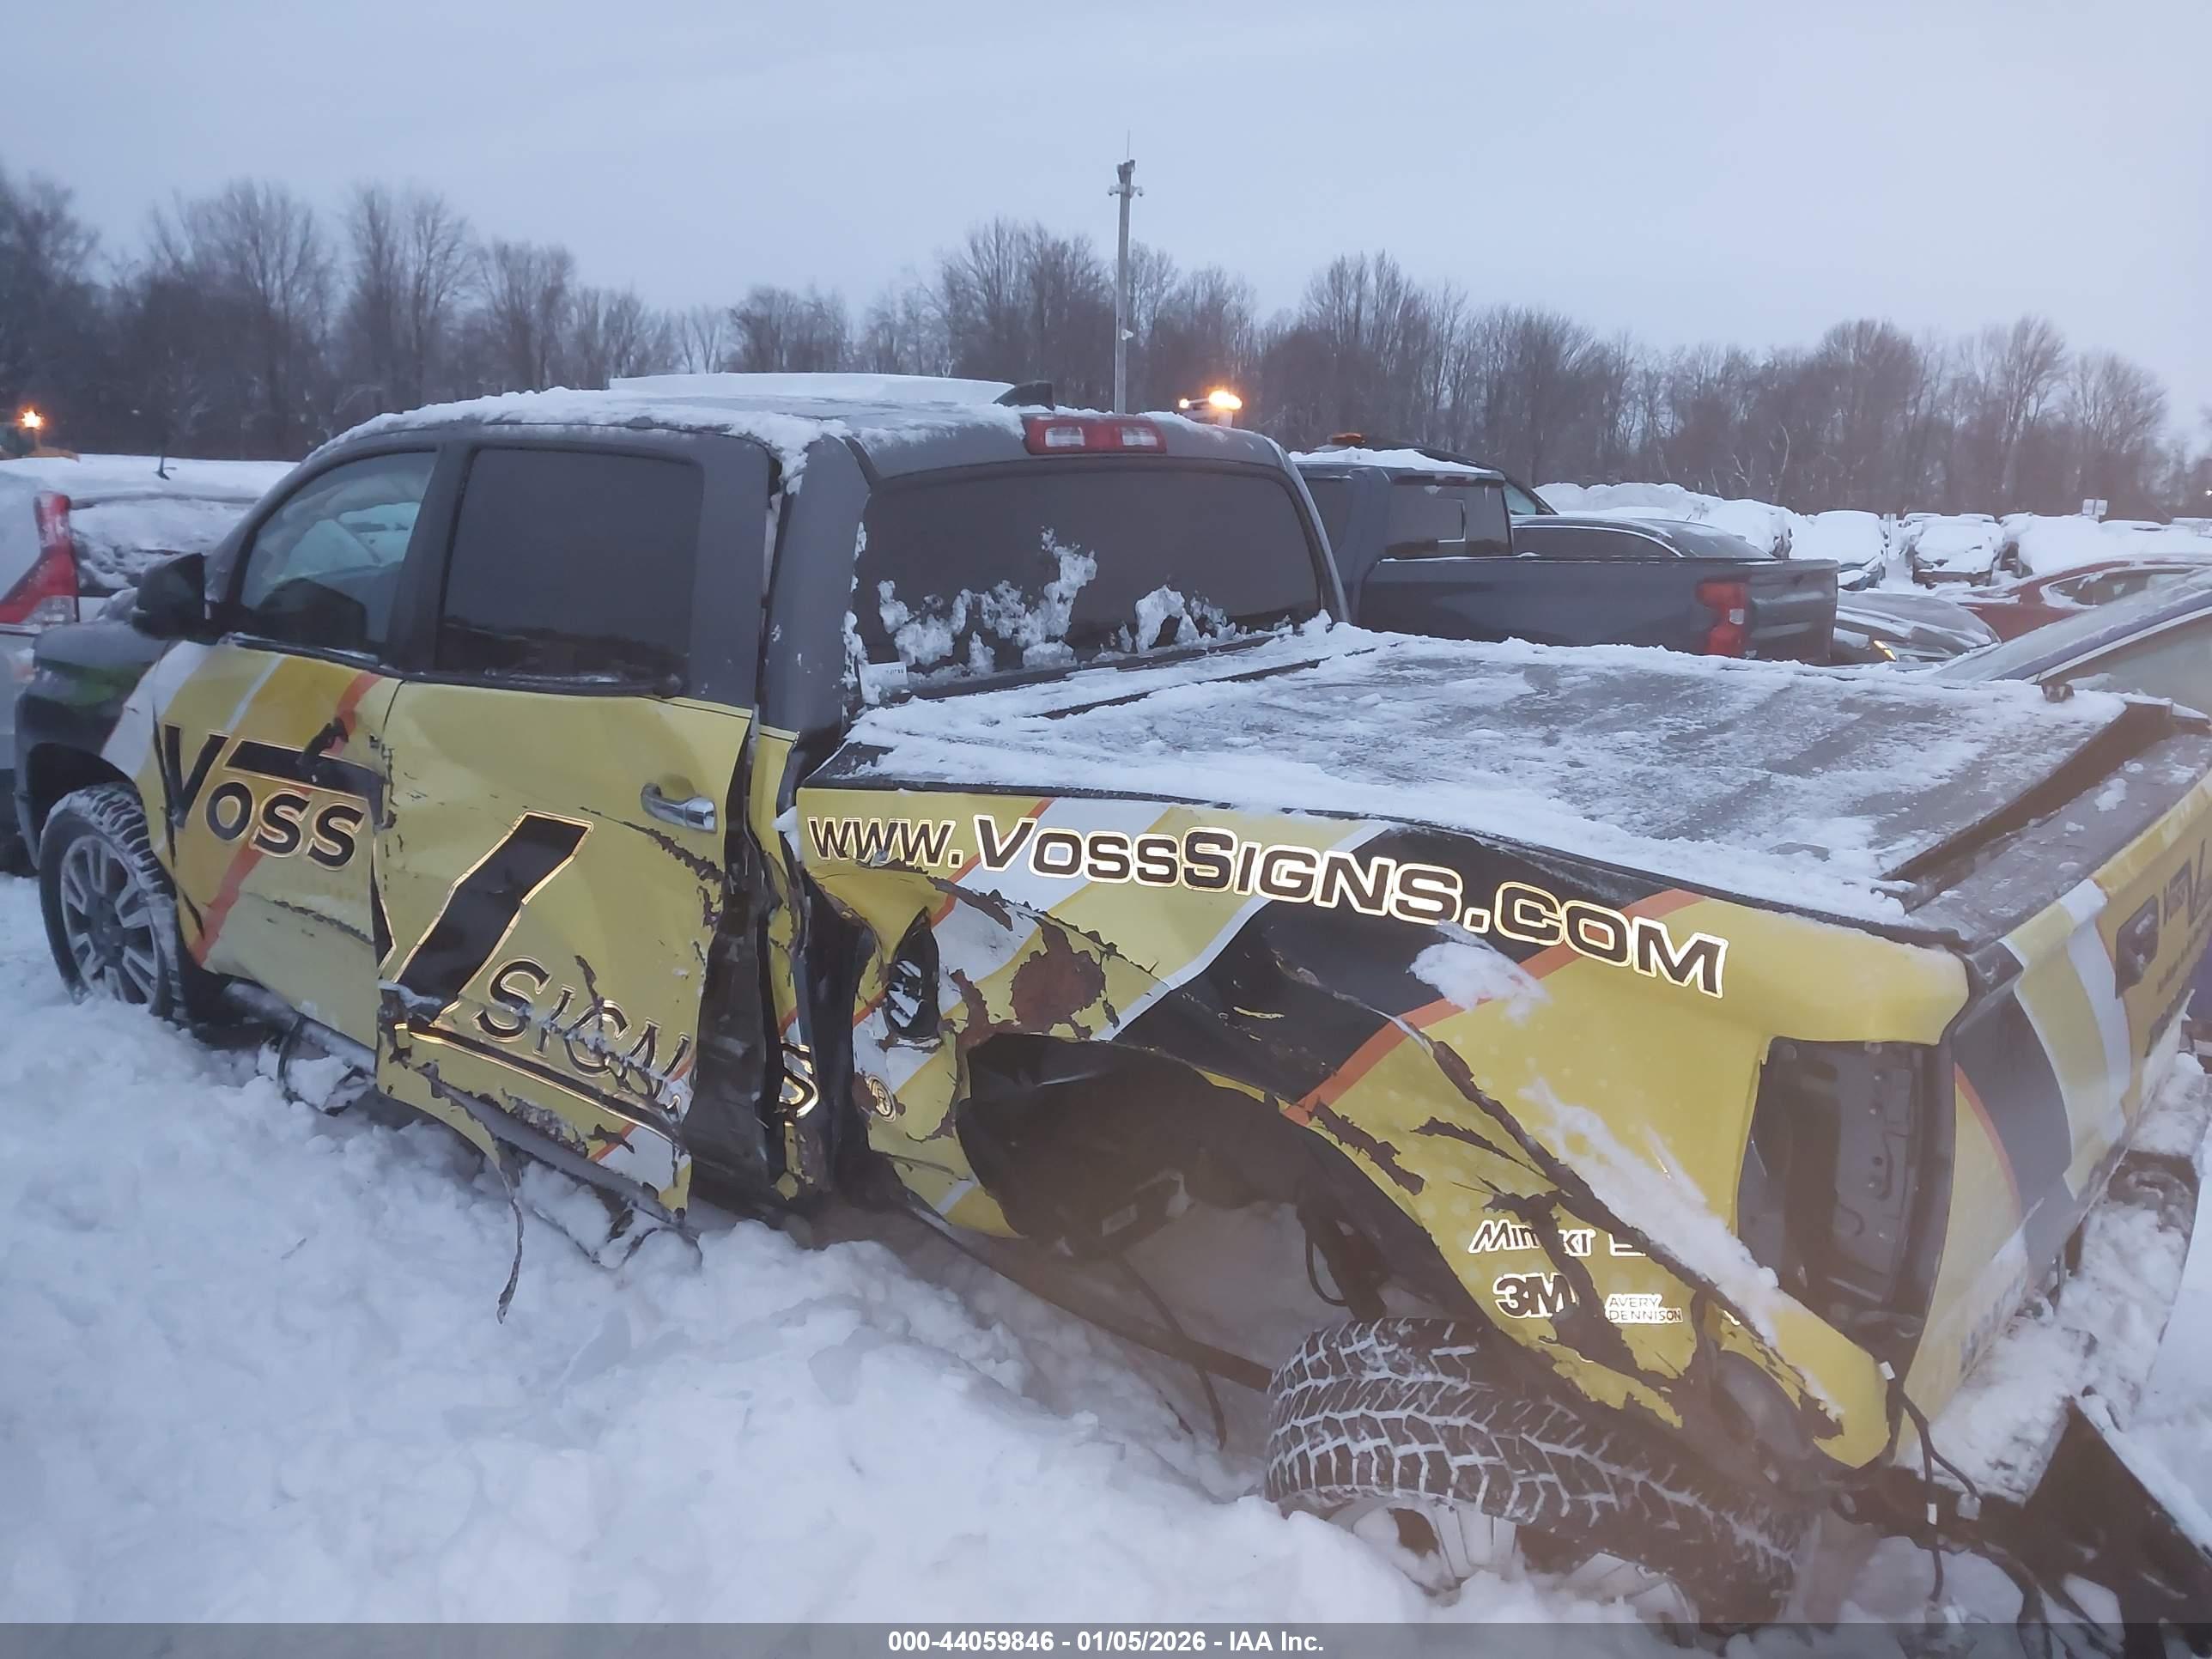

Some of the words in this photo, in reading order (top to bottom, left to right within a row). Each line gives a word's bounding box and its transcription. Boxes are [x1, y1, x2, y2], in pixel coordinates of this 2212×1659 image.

[1493, 1272, 1580, 1319] 3M
[1608, 1297, 1659, 1308] AVERY
[1608, 1310, 1681, 1322] DENNISON
